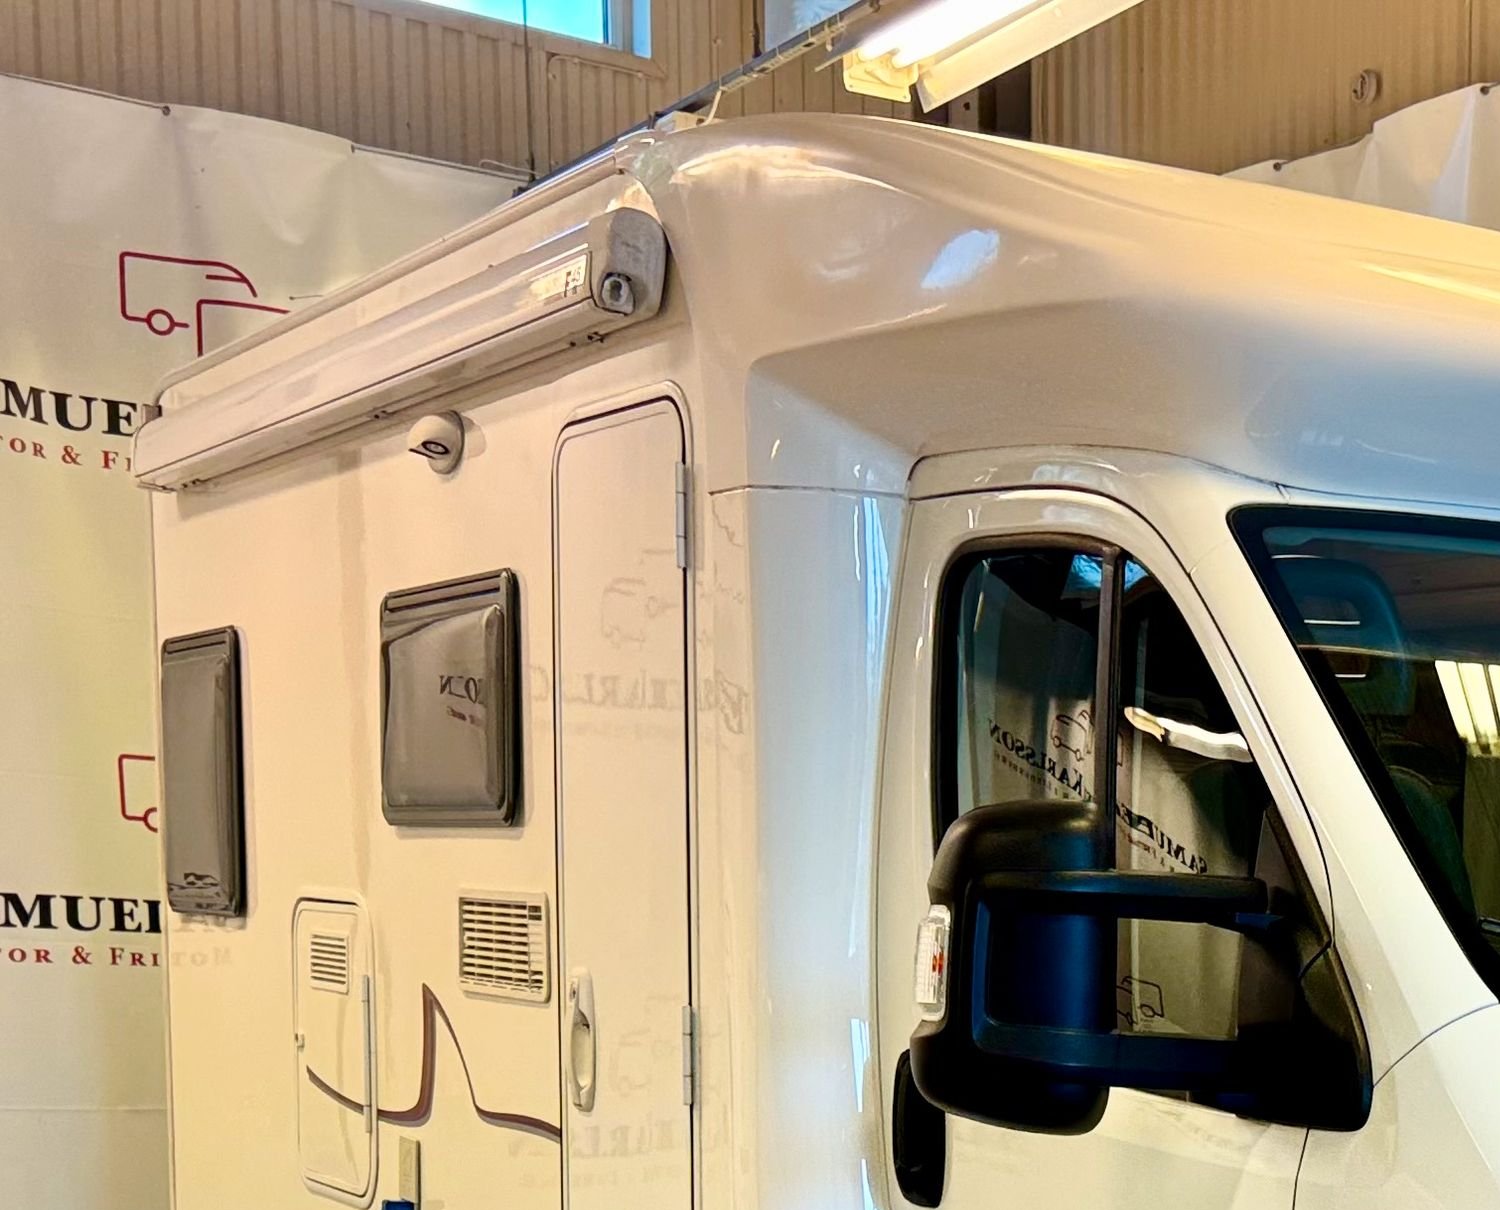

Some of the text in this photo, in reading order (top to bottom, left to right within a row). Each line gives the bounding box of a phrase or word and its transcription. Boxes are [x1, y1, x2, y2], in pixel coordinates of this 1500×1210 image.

[0, 379, 137, 437] MUE
[61, 445, 82, 466] &
[72, 946, 92, 965] &
[109, 947, 160, 967] FRI
